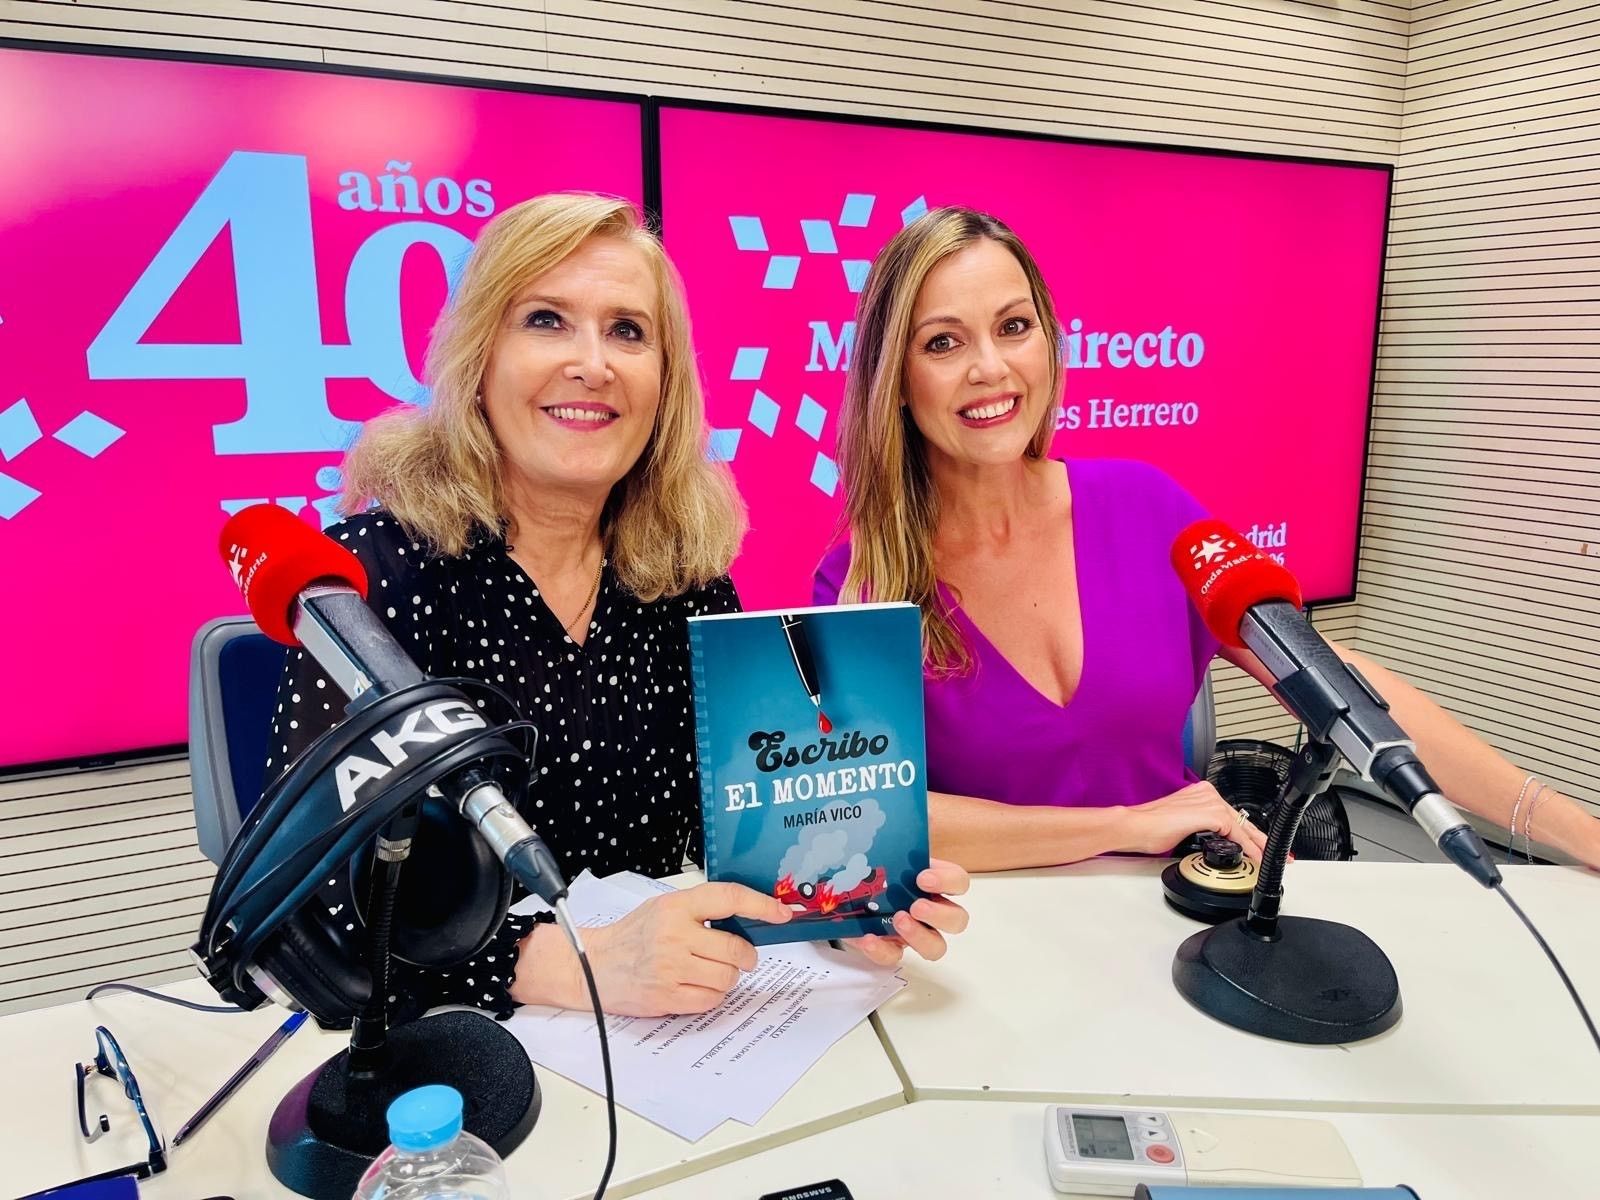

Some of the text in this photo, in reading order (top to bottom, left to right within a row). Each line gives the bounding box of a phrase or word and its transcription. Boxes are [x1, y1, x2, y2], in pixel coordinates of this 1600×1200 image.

[338, 161, 494, 216] años
[86, 150, 476, 456] 40
[1065, 318, 1204, 369] irecto
[1087, 398, 1199, 429] Herrero
[334, 700, 487, 813] AKG
[748, 730, 889, 773] Escribo
[725, 759, 916, 811] El MOMENTO
[783, 805, 862, 830] MARÍA VICO
